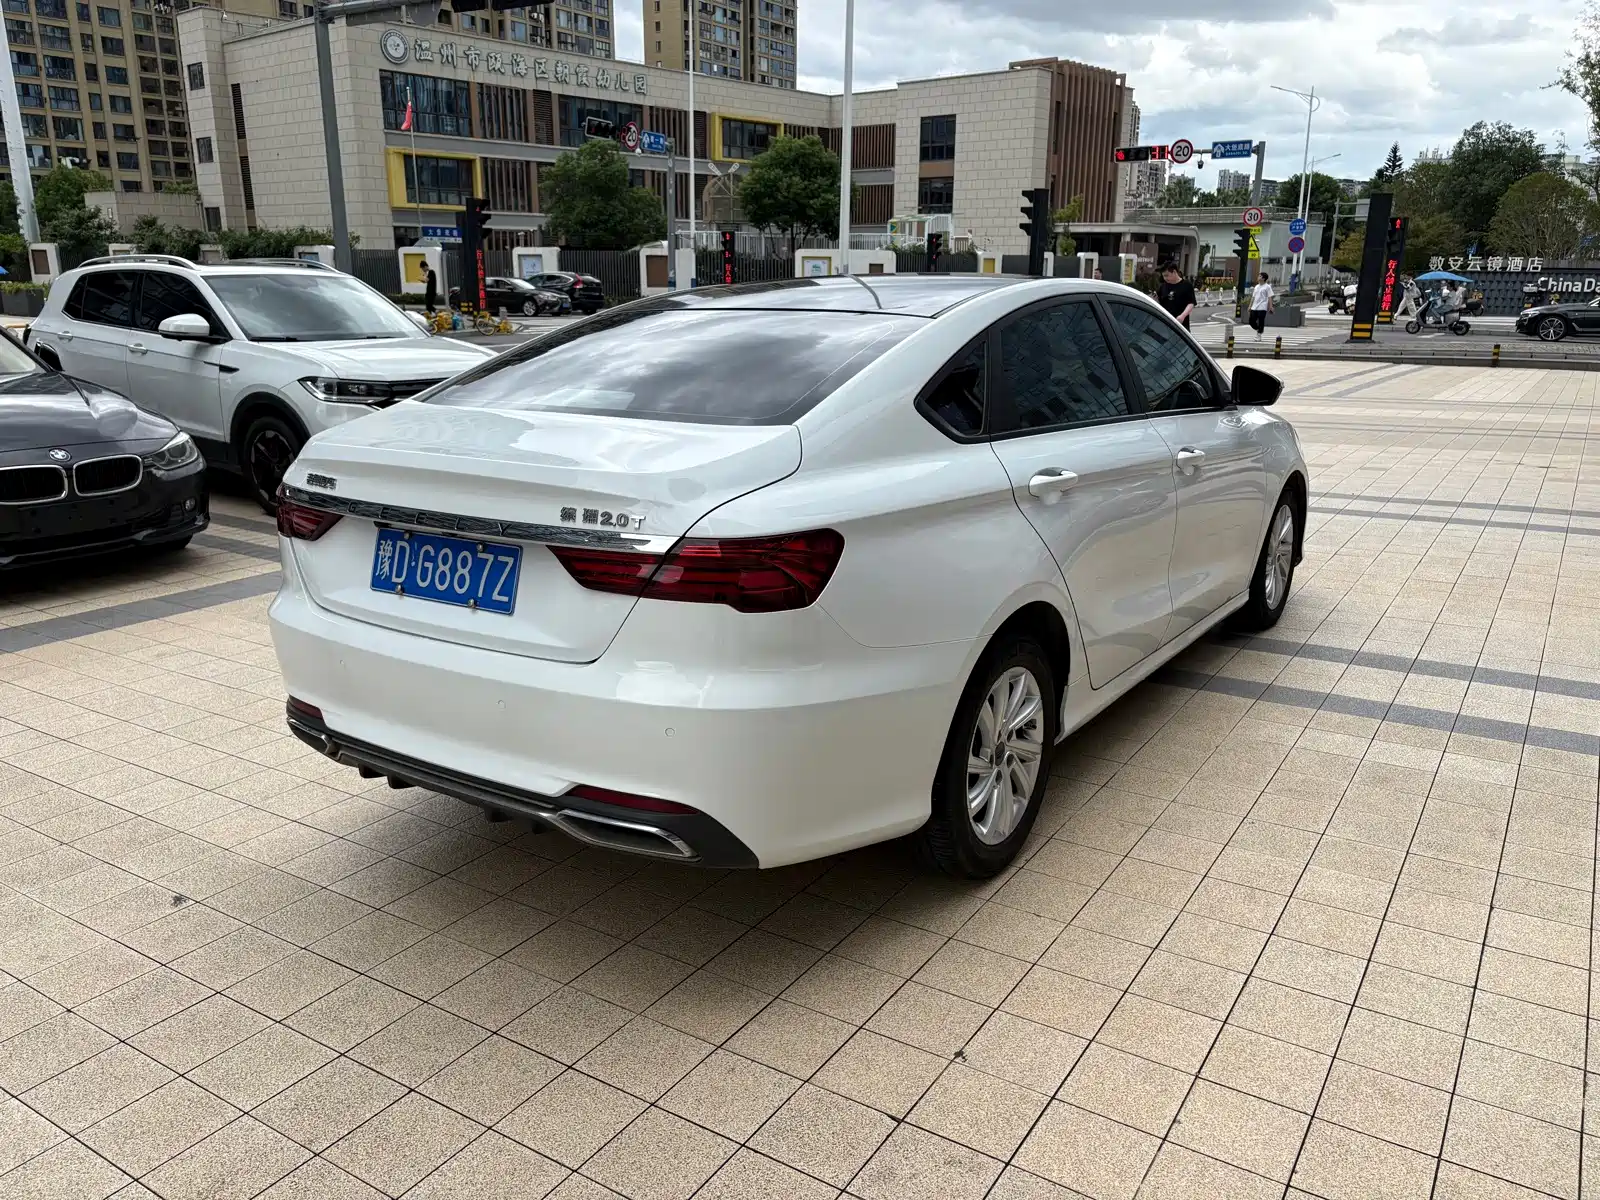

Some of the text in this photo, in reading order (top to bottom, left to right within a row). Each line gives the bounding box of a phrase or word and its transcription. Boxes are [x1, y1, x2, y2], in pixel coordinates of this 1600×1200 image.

[414, 38, 648, 96] 温州市瓯海区朝霞幼儿园
[627, 129, 636, 142] 20
[1151, 145, 1168, 160] 31
[1175, 145, 1189, 157] 20
[1247, 212, 1259, 222] 30
[1428, 256, 1544, 273] 数安云镜酒店
[347, 500, 513, 537] GEELY
